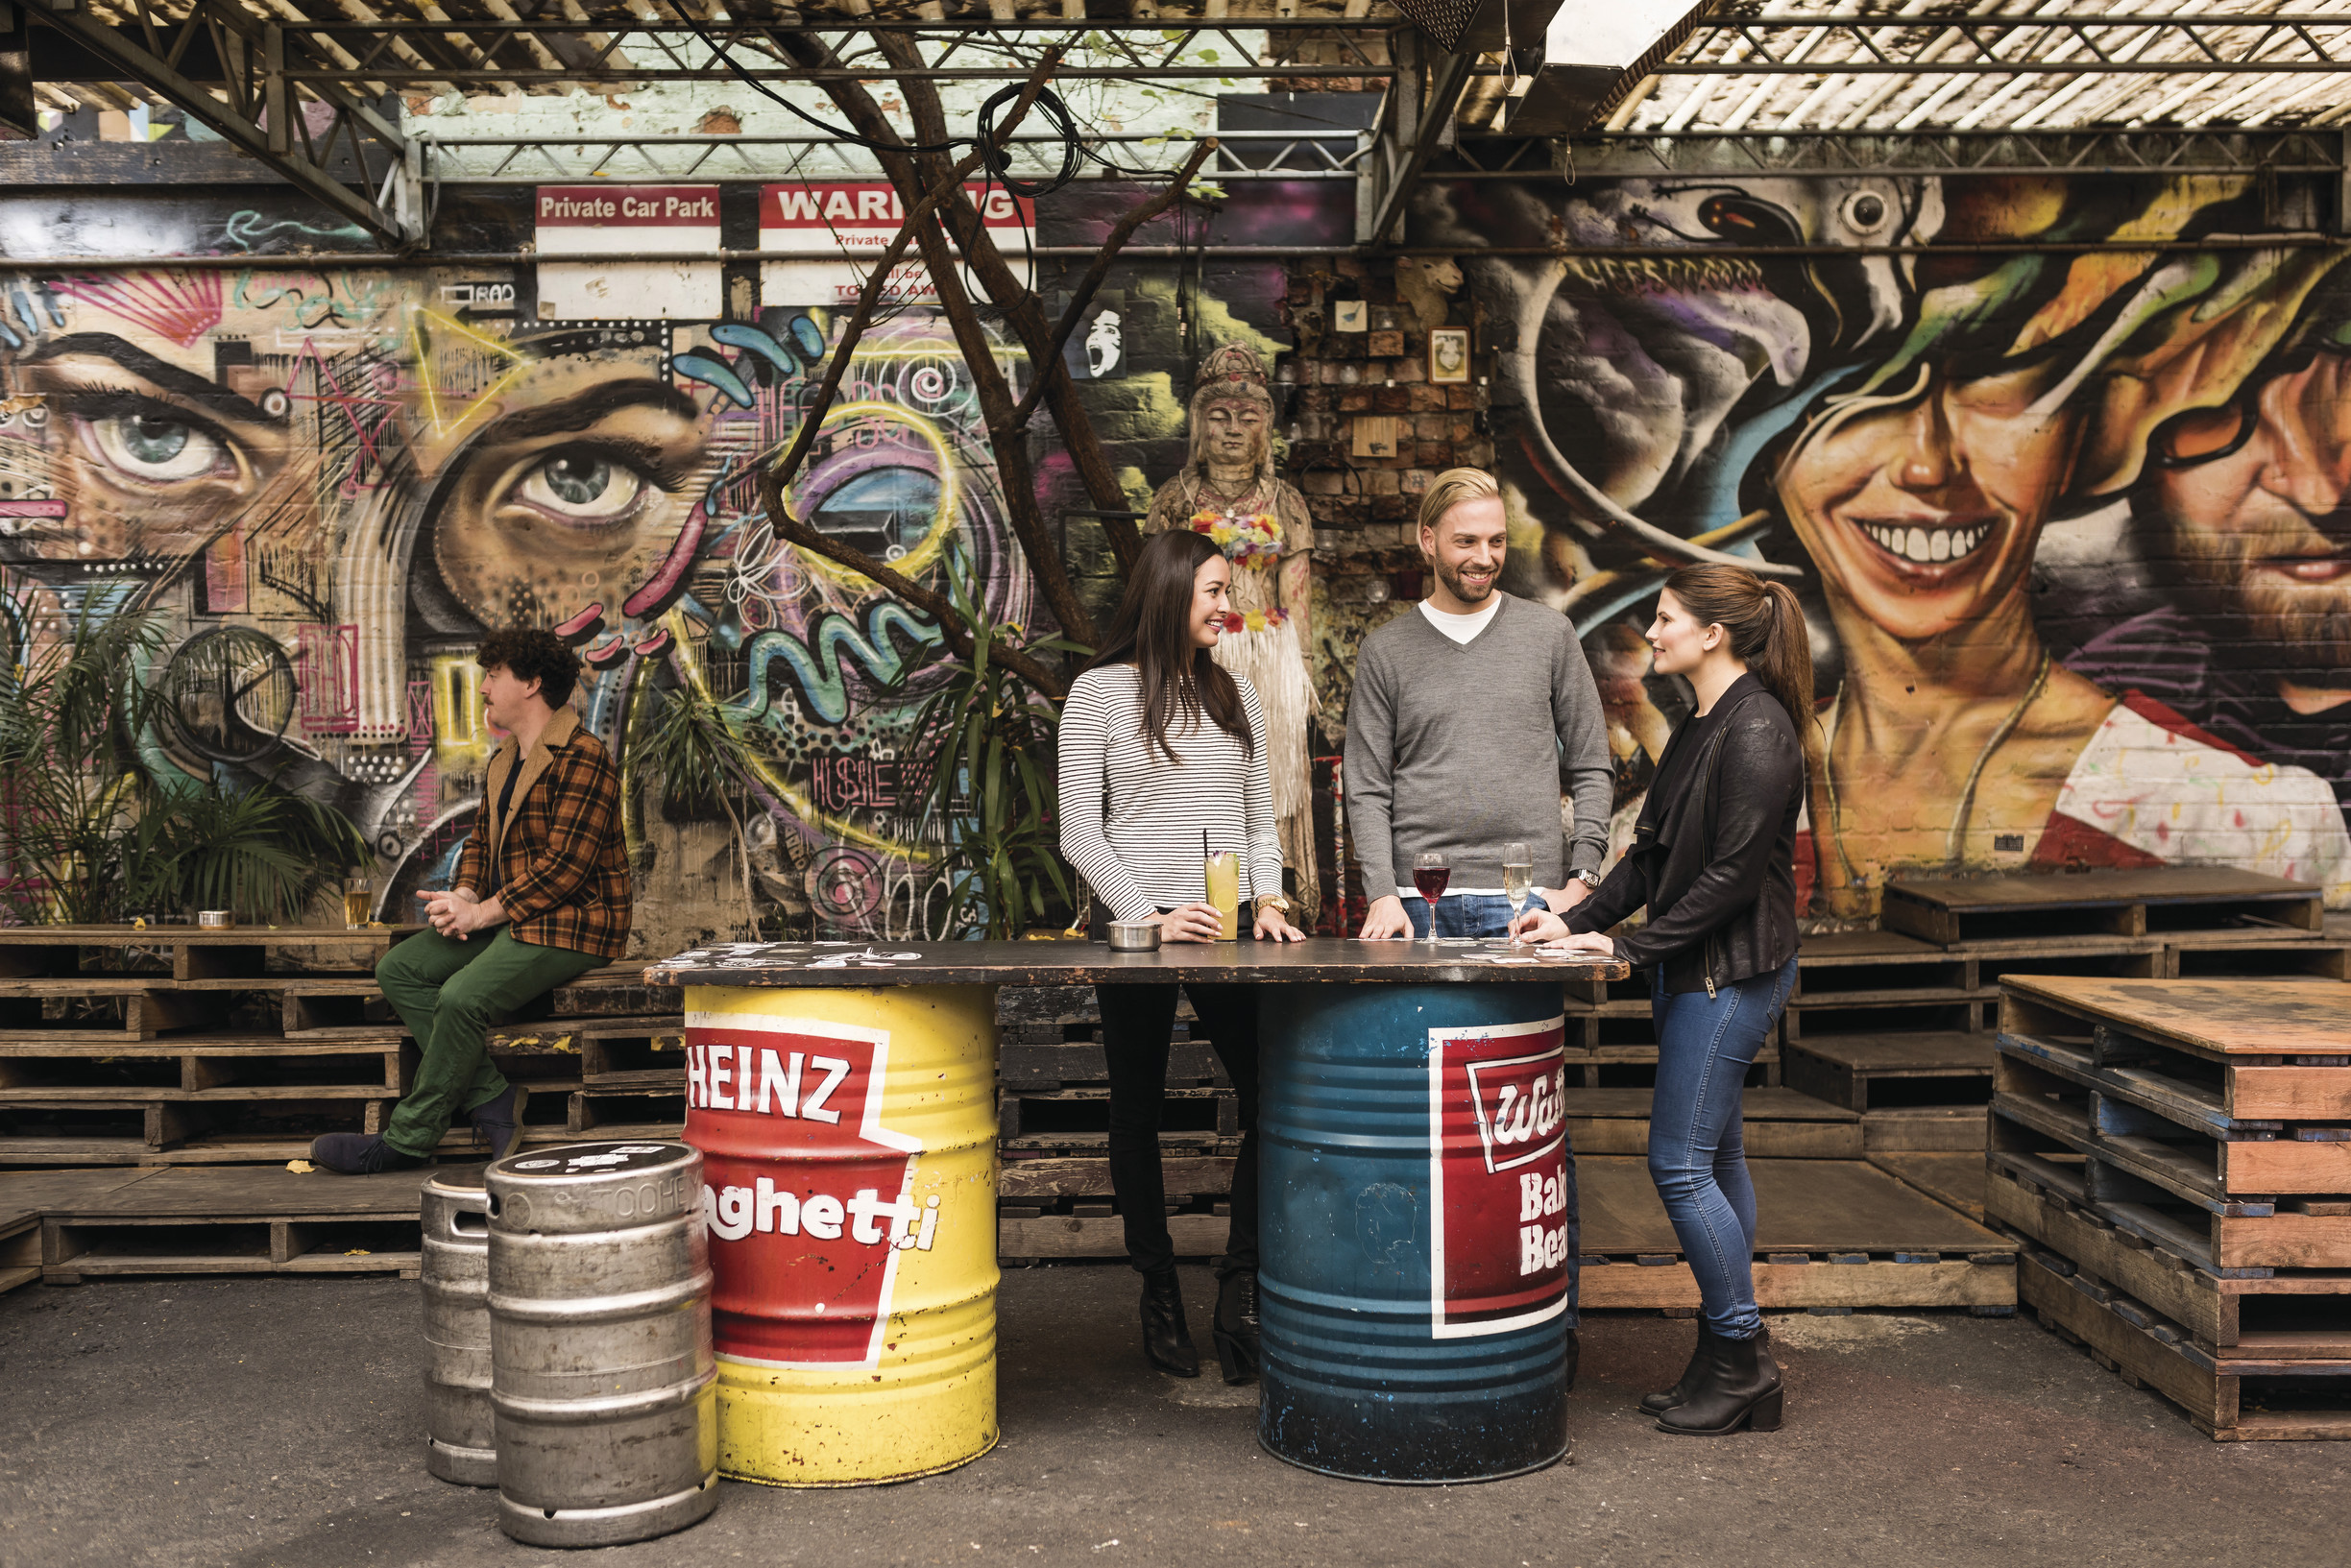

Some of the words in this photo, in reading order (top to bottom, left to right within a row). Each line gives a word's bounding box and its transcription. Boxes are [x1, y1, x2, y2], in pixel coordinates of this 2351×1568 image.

[541, 197, 616, 217] Private
[622, 196, 659, 217] Car
[665, 197, 715, 217] Park
[835, 234, 888, 246] Private
[906, 268, 923, 278] be
[835, 285, 901, 296] TOED
[687, 1044, 851, 1125] HEINZ
